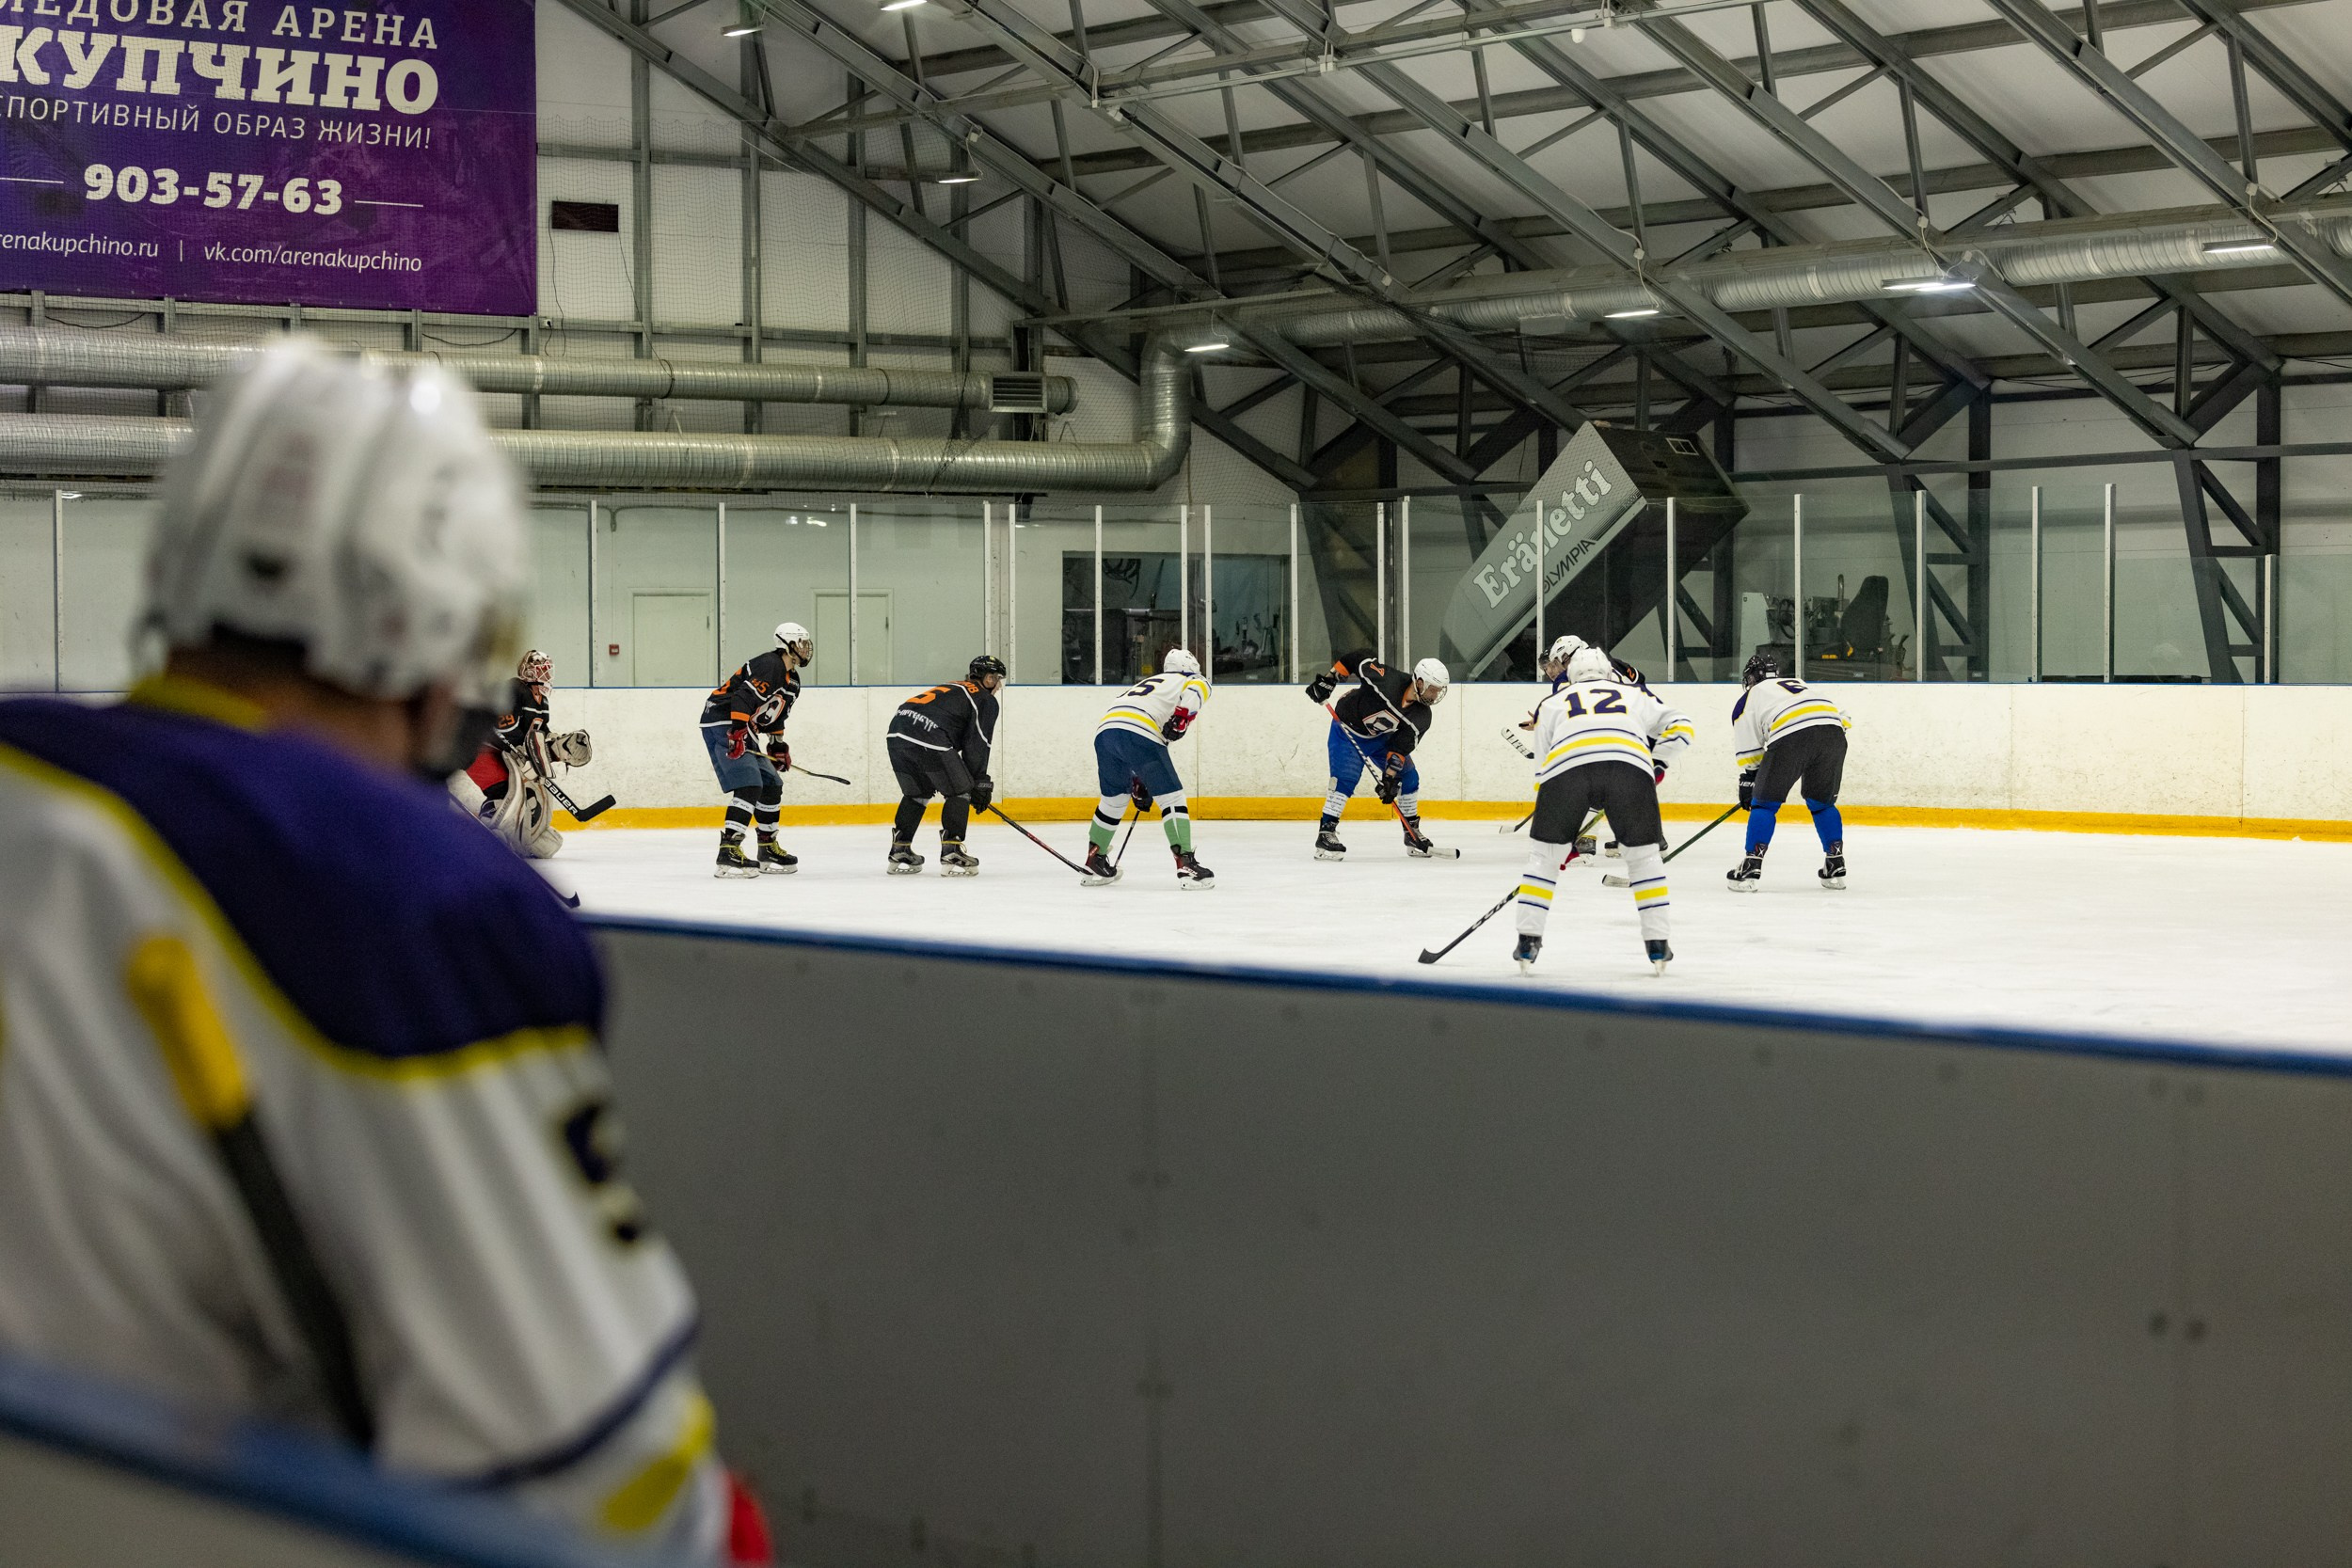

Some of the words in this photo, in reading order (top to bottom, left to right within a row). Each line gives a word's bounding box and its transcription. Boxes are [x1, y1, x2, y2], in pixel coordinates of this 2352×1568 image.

[272, 5, 437, 49] АРЕНА
[0, 24, 439, 115] КУПЧИНО
[0, 95, 199, 133] ПОРТИВНЫЙ
[214, 112, 306, 139] ОБРАЗ
[317, 119, 431, 150] ЖИЗНИ!
[84, 163, 342, 216] 903-57-63
[0, 231, 159, 257] enakupchino.ru
[204, 241, 422, 274] vk.com/arenakupchino
[1472, 459, 1612, 610] Eränetti
[1565, 689, 1627, 719] 12
